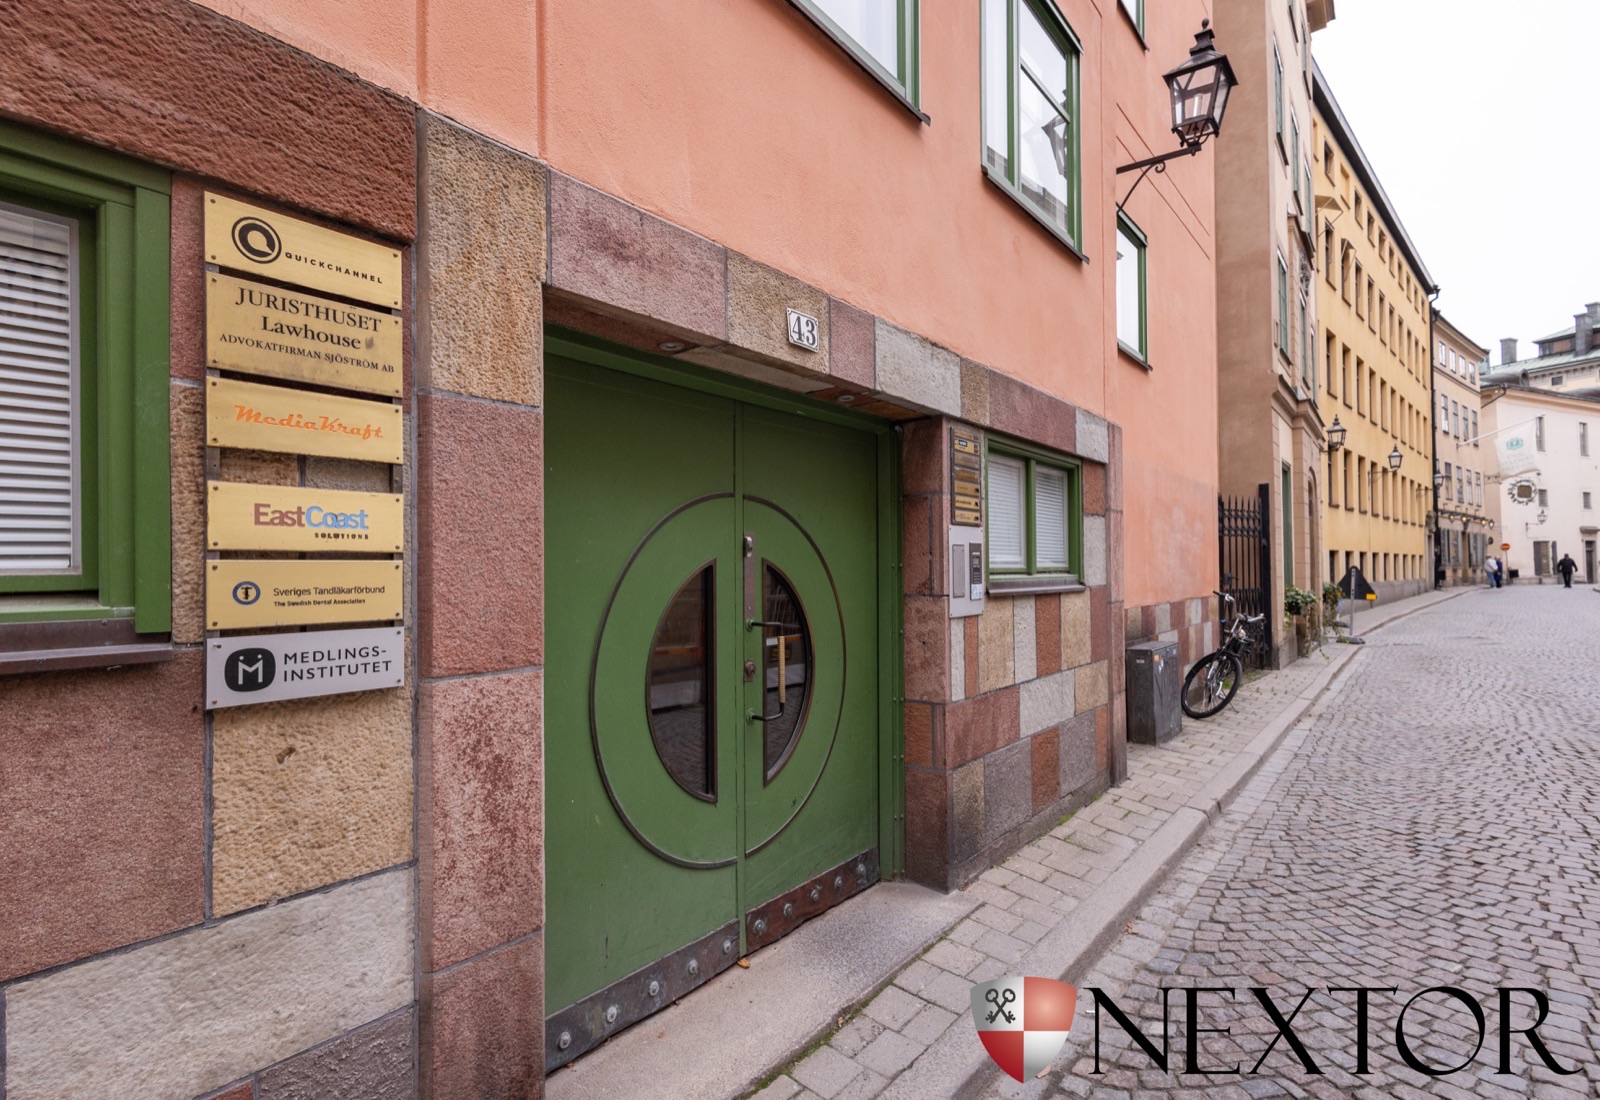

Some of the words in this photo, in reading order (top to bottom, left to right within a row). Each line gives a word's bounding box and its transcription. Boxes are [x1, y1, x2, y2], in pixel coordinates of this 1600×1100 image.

[285, 252, 383, 284] QUICKCHANNEL
[235, 287, 381, 332] JURISTHUSET
[261, 316, 361, 349] Lawhouse
[792, 316, 816, 346] 43
[220, 333, 321, 359] ADVOKATFIRMAN
[324, 353, 378, 370] SJÖSTRÖM
[381, 364, 394, 373] AB
[234, 405, 383, 439] MediaKraft
[314, 532, 369, 540] SOLUTIONS
[273, 587, 312, 597] Sveriges
[313, 585, 385, 595] Tandläkarförbund
[284, 646, 387, 665] MEDLINGS-
[284, 660, 392, 682] INSTITUTET
